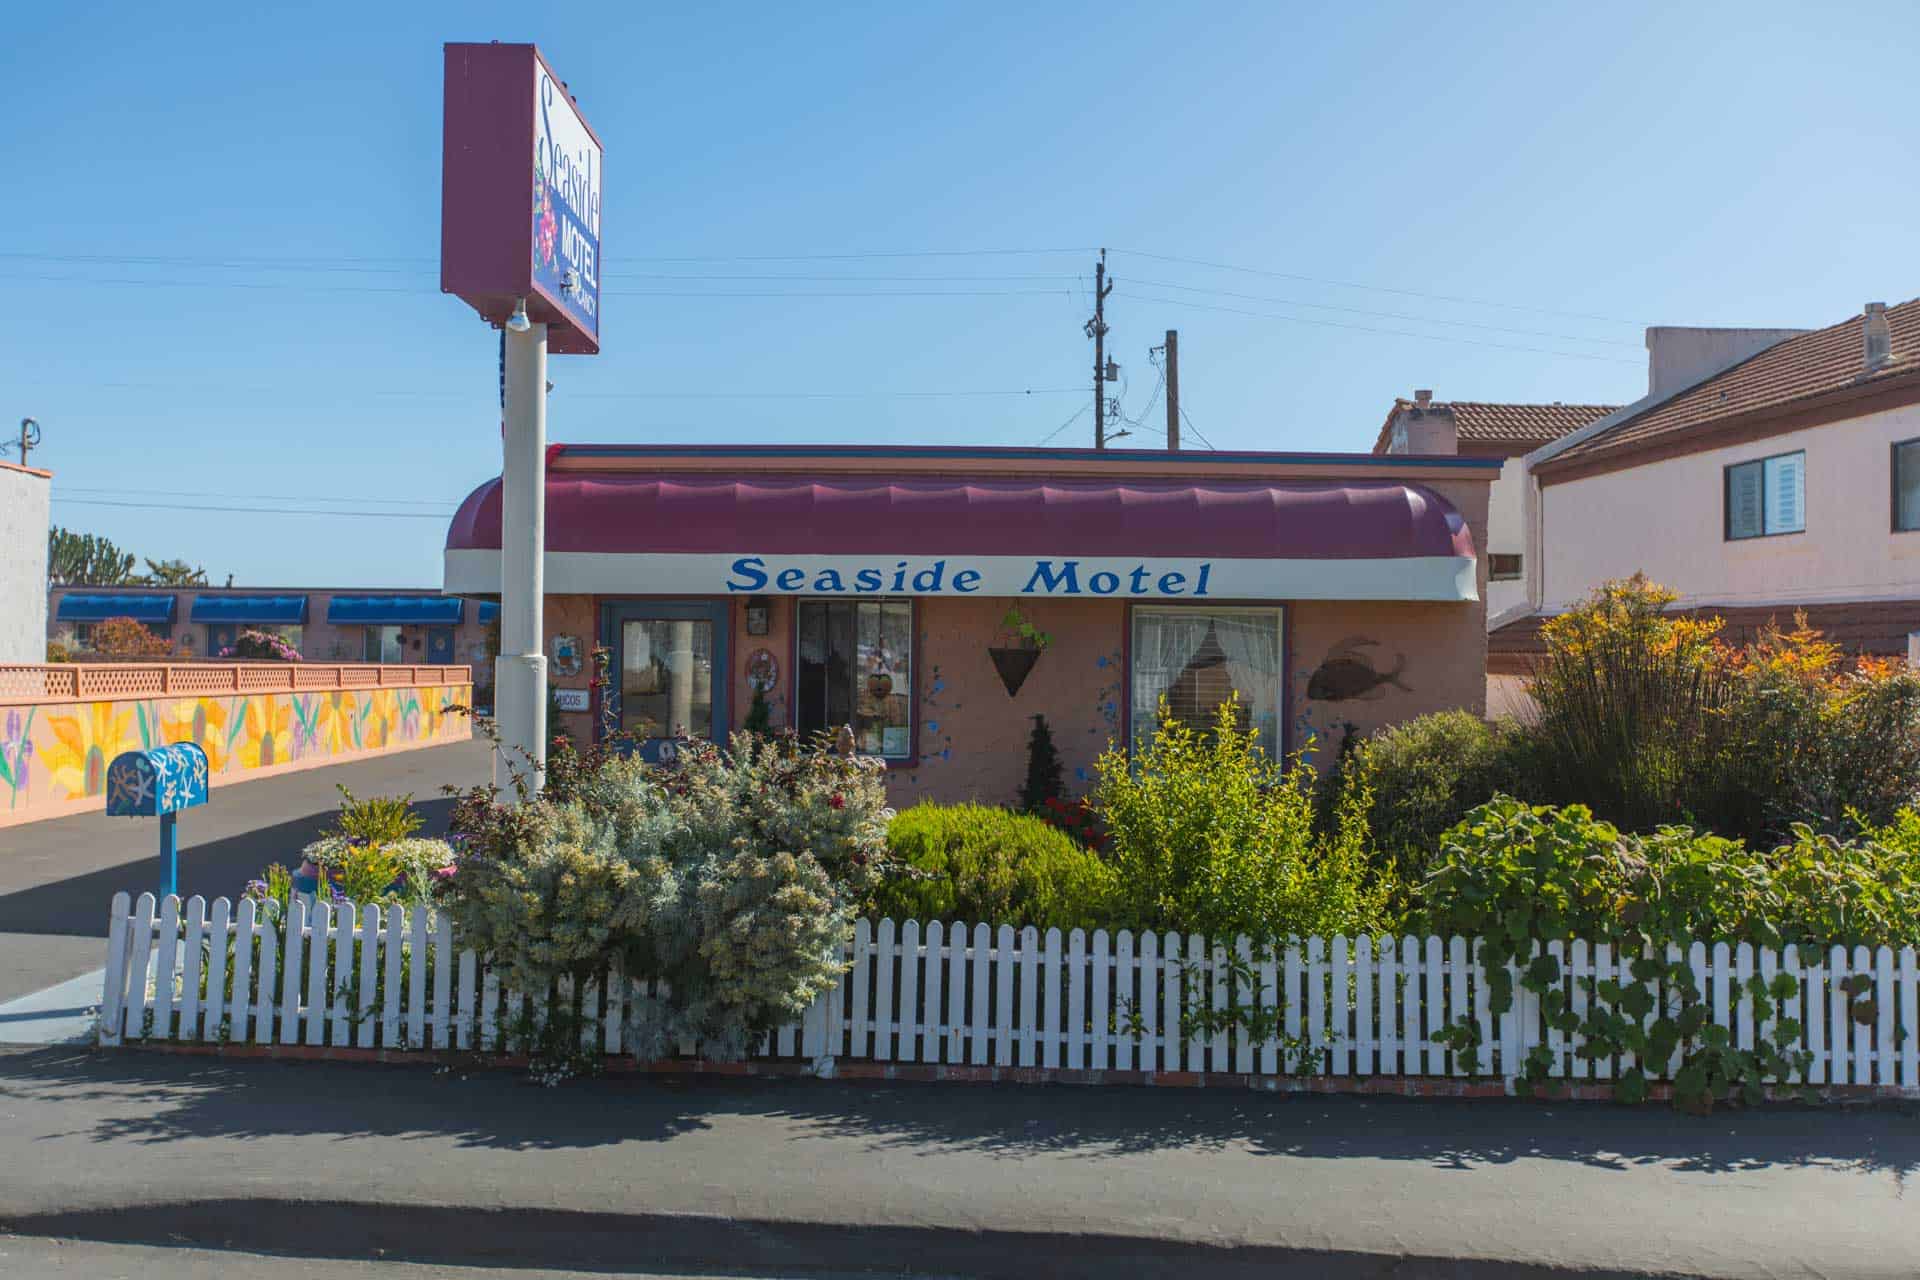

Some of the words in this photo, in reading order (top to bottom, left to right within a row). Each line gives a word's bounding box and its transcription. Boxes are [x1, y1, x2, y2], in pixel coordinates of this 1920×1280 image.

[539, 75, 599, 237] Seaside
[562, 213, 597, 288] MOTEL
[726, 557, 982, 593] Seaside
[1021, 561, 1211, 595] Motel
